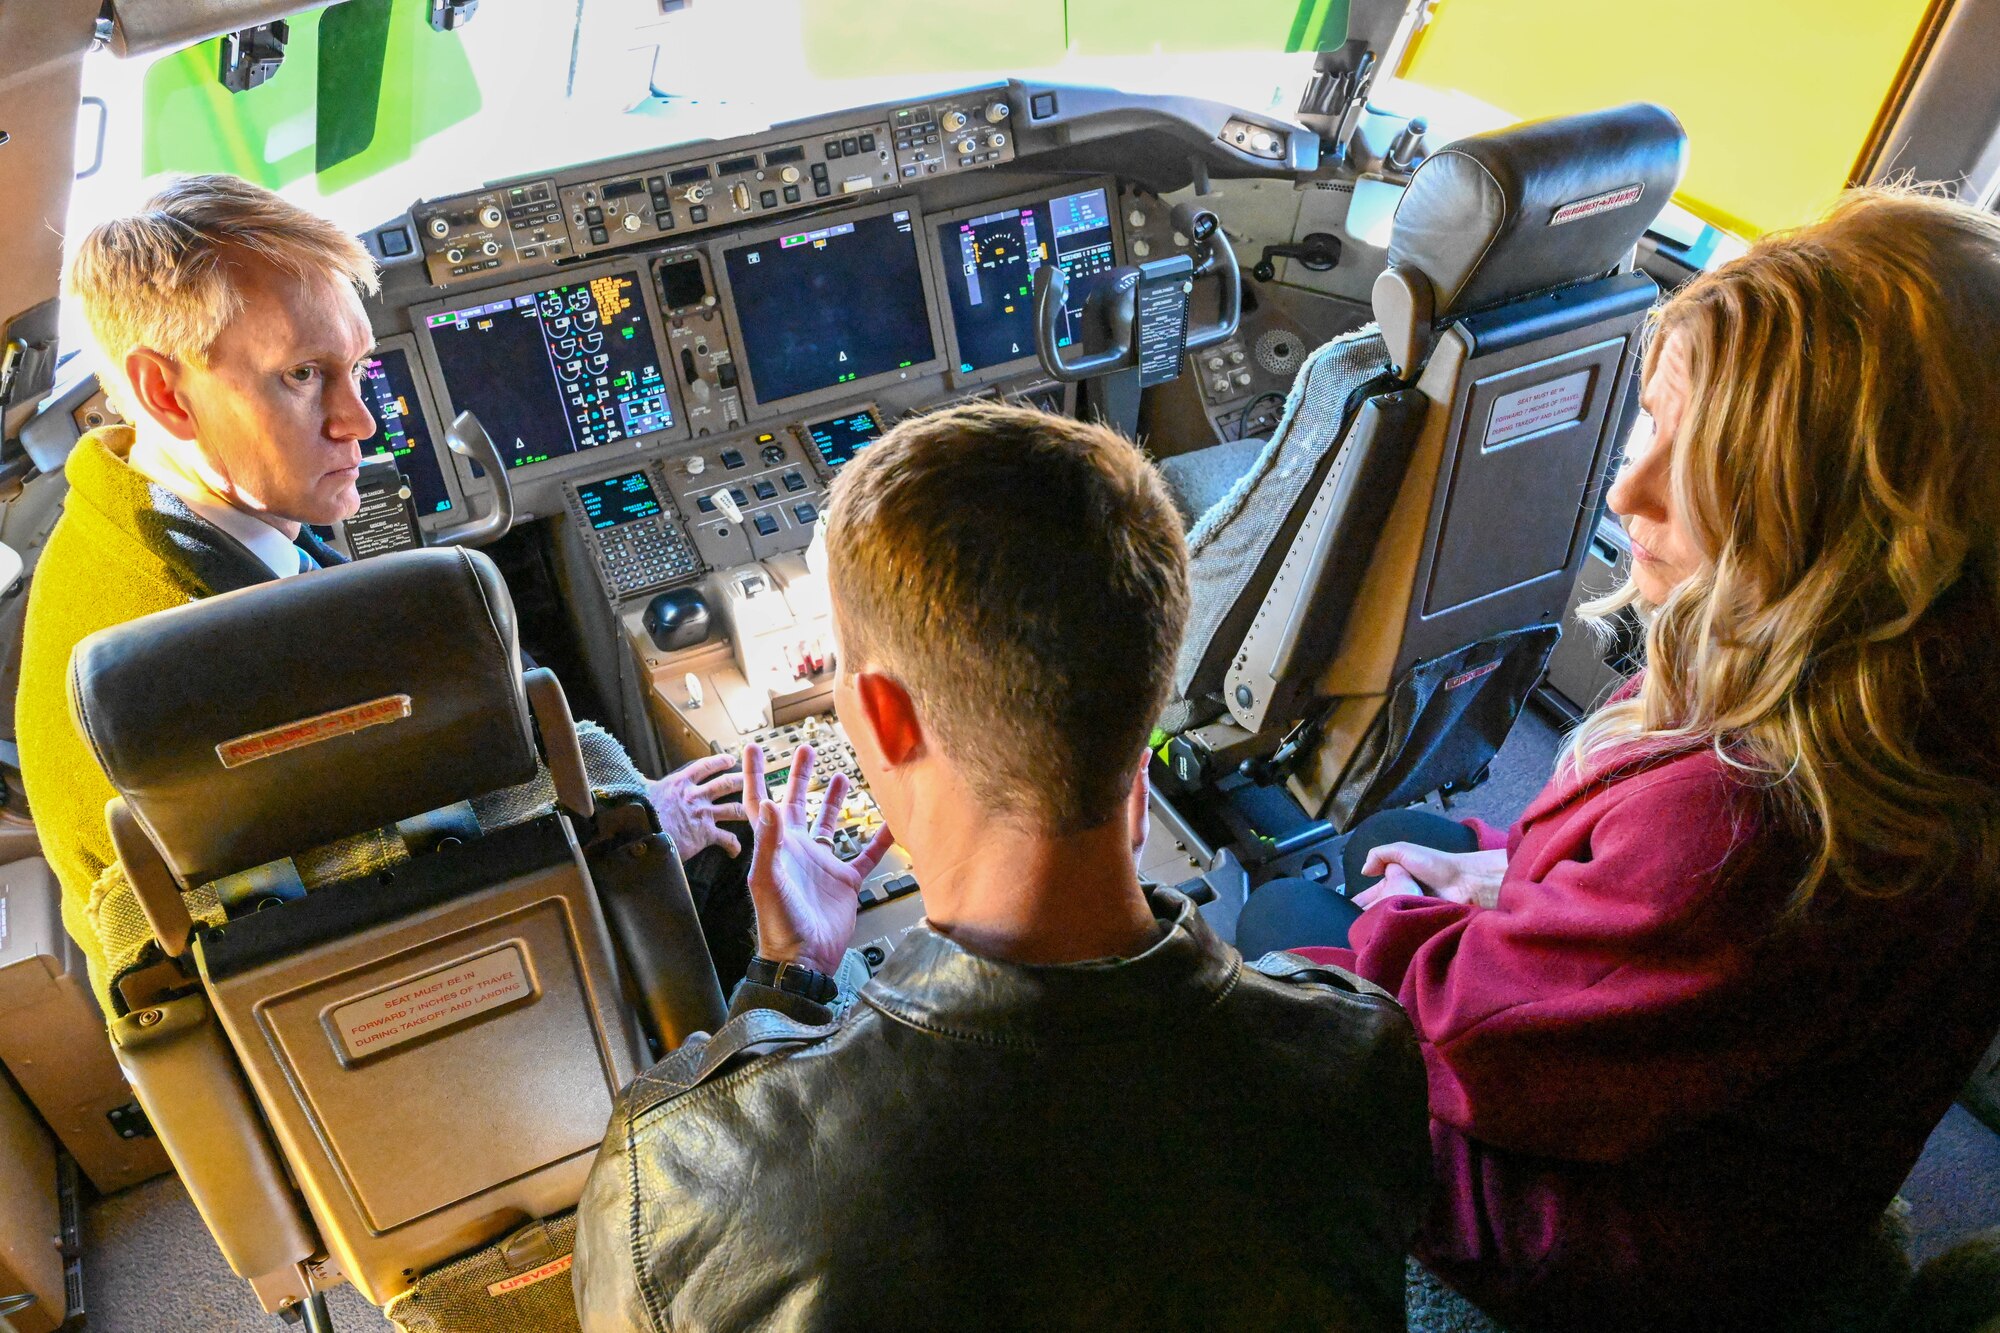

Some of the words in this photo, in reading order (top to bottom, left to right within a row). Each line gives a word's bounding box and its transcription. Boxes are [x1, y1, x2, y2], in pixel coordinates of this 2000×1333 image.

[1495, 410, 1523, 423] FORWARD
[1560, 393, 1579, 404] TRAVEL
[1517, 396, 1533, 406] SEAT
[1534, 391, 1549, 401] MUST
[1540, 413, 1552, 421] AND
[1553, 404, 1578, 416] LANDING
[351, 1009, 406, 1035] FORWARD
[418, 991, 457, 1012] INCHES
[460, 985, 474, 996] OF
[477, 970, 515, 990] TRAVEL
[384, 994, 410, 1009] SEAT
[414, 982, 444, 999] MUST
[447, 976, 462, 988] BE
[464, 971, 476, 983] IN
[355, 1027, 399, 1047] DURING
[400, 1009, 447, 1030] TAKEOFF
[449, 1000, 472, 1013] AND
[475, 982, 521, 1004] LANDING
